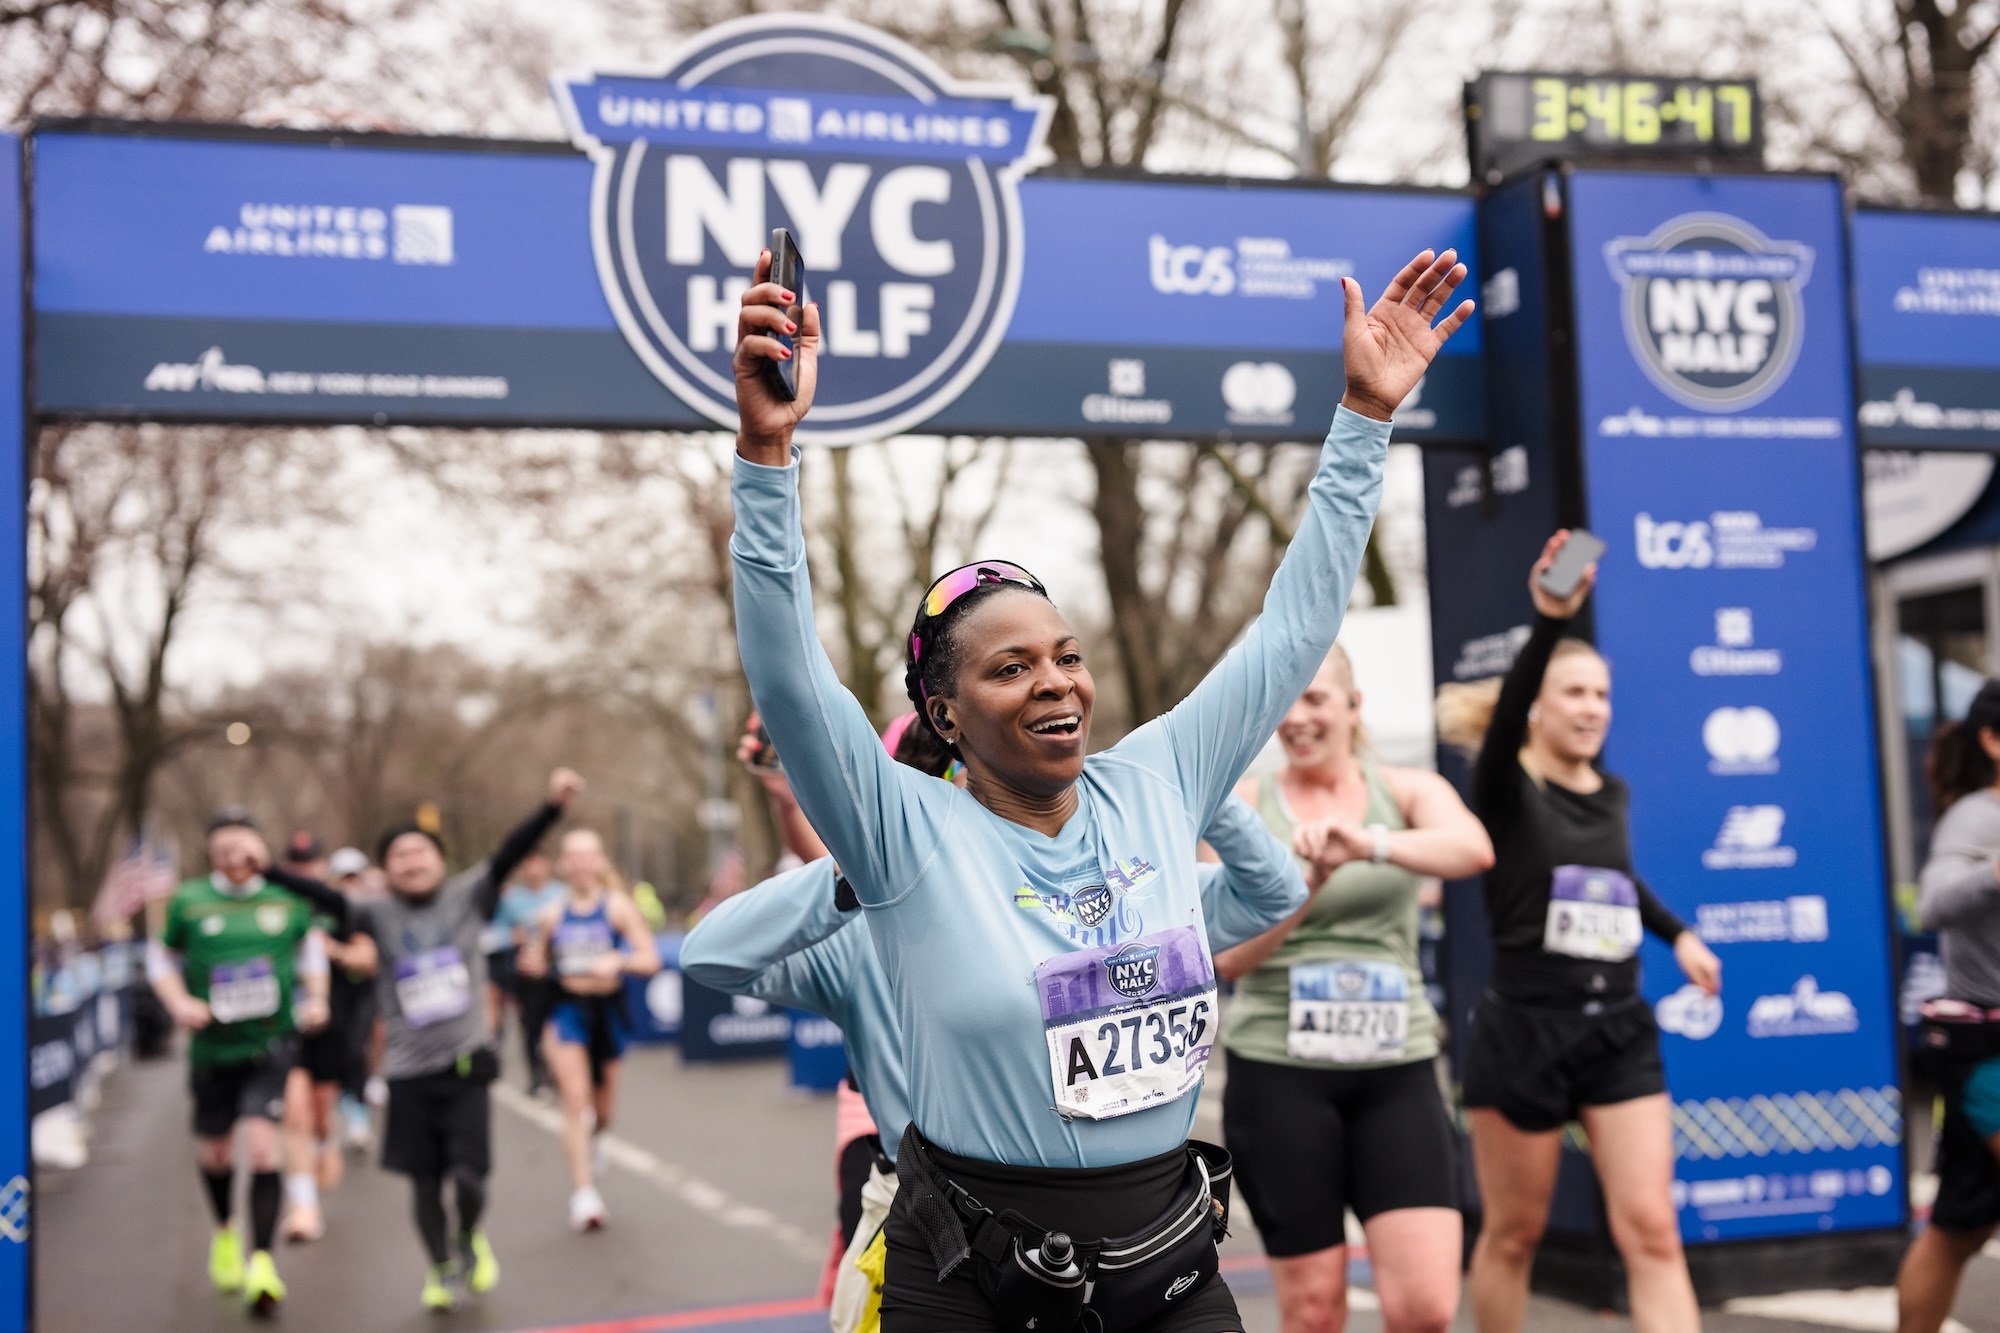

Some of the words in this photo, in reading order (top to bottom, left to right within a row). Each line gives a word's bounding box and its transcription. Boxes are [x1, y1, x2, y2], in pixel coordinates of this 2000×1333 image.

[600, 96, 764, 134] UNITED
[816, 108, 1011, 148] AIRLINES
[240, 202, 387, 234] UNITED
[665, 155, 955, 276] NYC
[205, 225, 387, 260] AIRLINES
[1149, 233, 1236, 296] tcs
[687, 276, 935, 357] HLF
[1650, 278, 1776, 334] NYC
[1660, 332, 1769, 373] HALF
[1634, 511, 1713, 569] tcs
[1078, 891, 1109, 916] NYC
[1116, 958, 1153, 980] NYC
[1120, 975, 1152, 990] HALF
